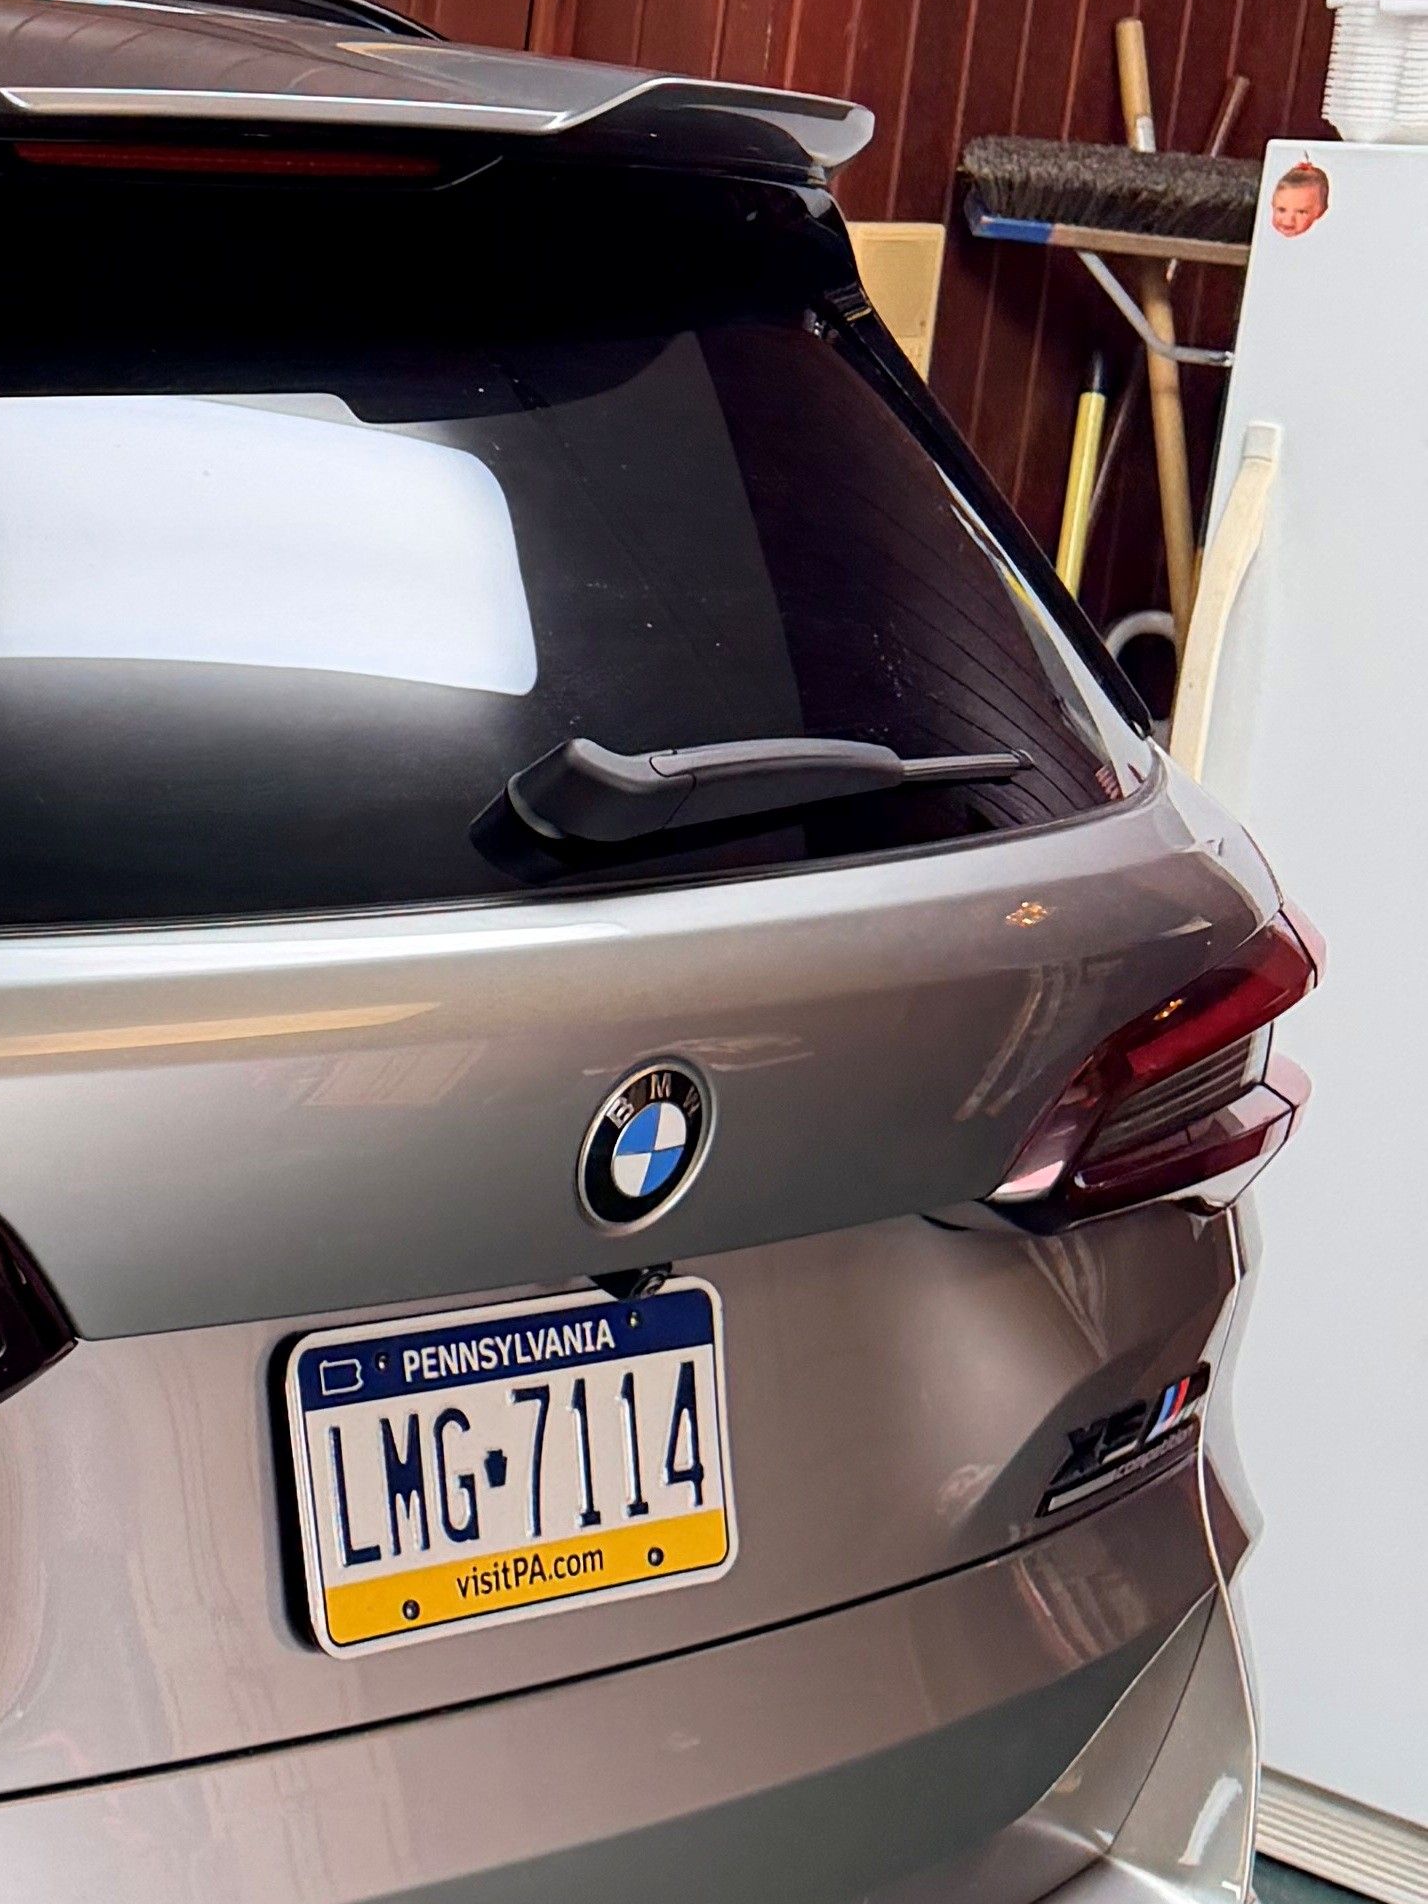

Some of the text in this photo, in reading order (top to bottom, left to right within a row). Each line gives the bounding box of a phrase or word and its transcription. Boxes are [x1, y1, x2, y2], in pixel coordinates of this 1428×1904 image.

[605, 1073, 701, 1129] BMW
[402, 1318, 616, 1383] PENNSYLVANIA
[327, 1360, 705, 1568] LMG 7114
[456, 1548, 605, 1599] visitPA.com
